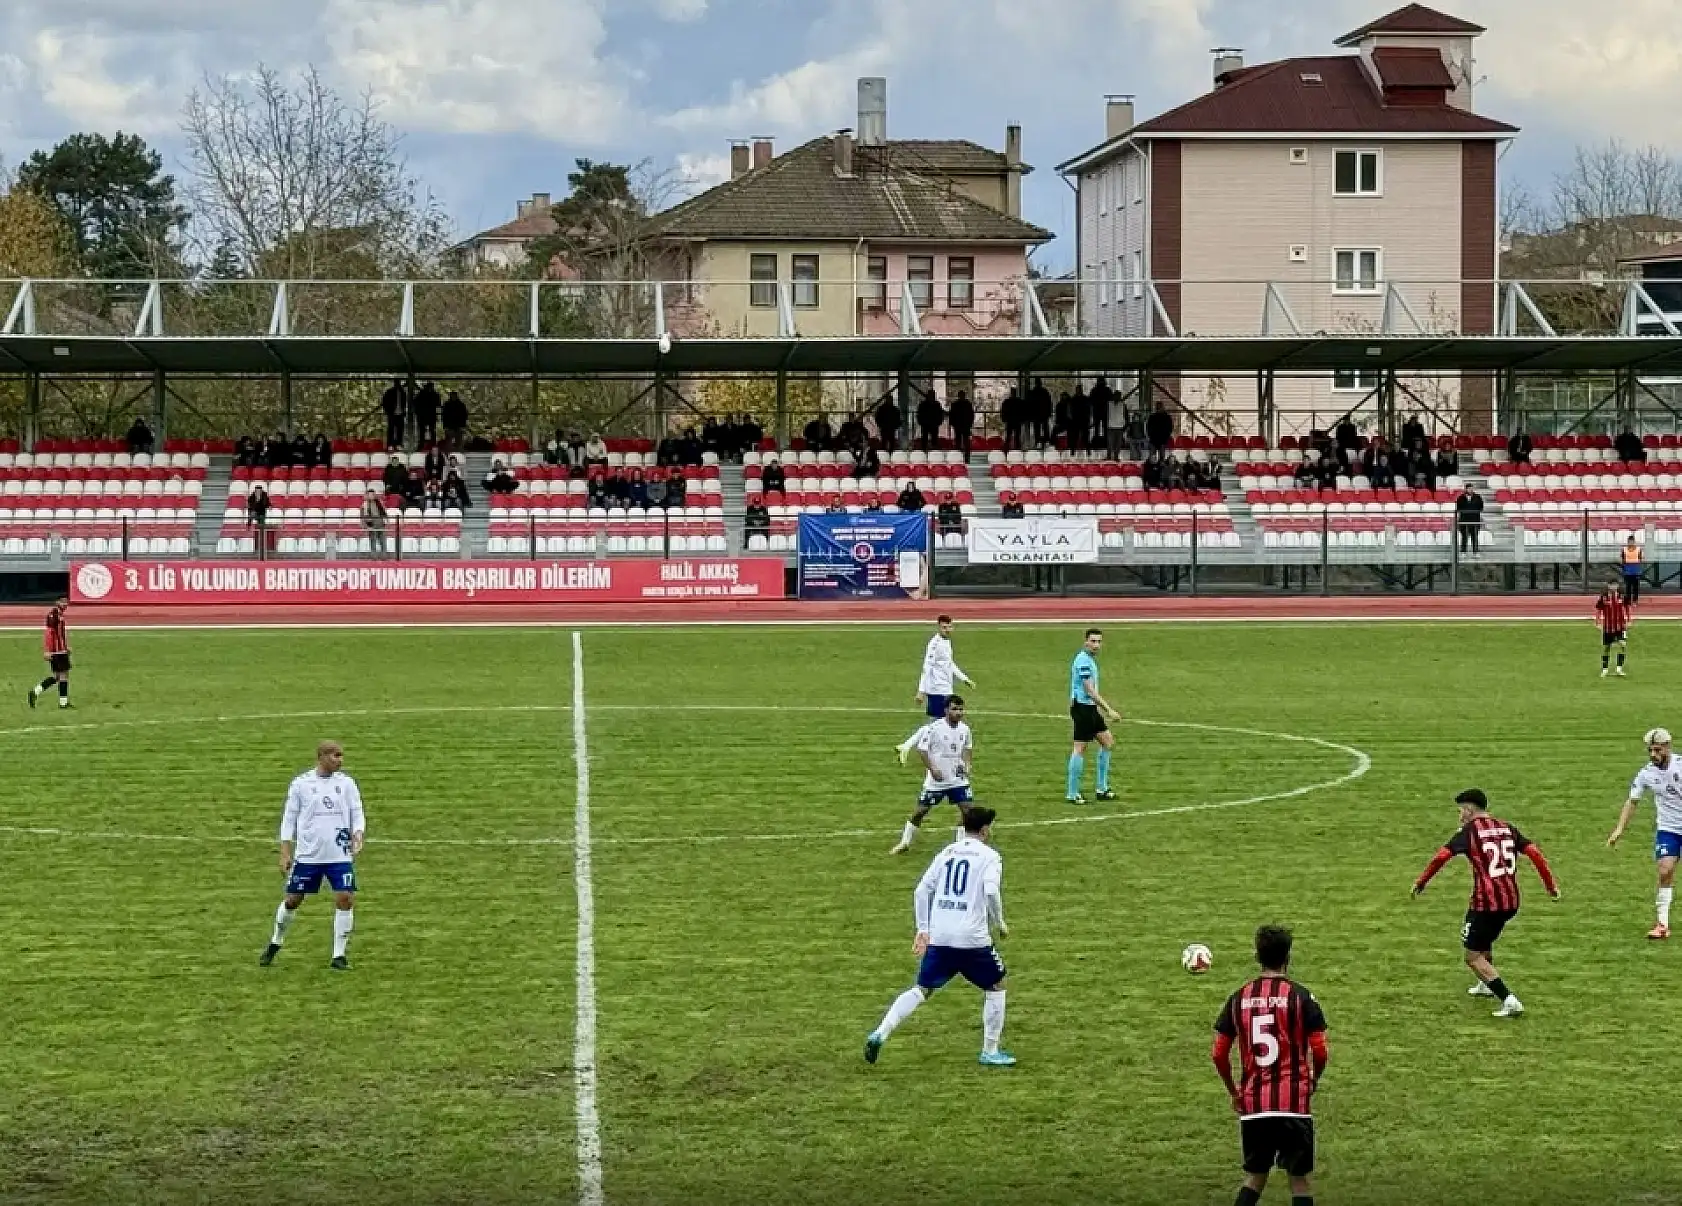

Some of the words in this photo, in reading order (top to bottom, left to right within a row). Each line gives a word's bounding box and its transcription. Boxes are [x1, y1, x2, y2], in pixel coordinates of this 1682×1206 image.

[992, 553, 1075, 562] LOKANTASI
[997, 534, 1071, 546] YAYLA
[125, 568, 143, 590] 3.
[149, 563, 176, 590] LİG
[181, 567, 260, 590] YOLUNDA
[265, 567, 437, 590] BARTINSPOR'UMUZA
[442, 567, 536, 596] BAŞARILAR
[541, 563, 611, 590] DİLERİM
[943, 857, 971, 896] 10
[1482, 840, 1516, 878] 25
[1252, 1014, 1279, 1067] 5
